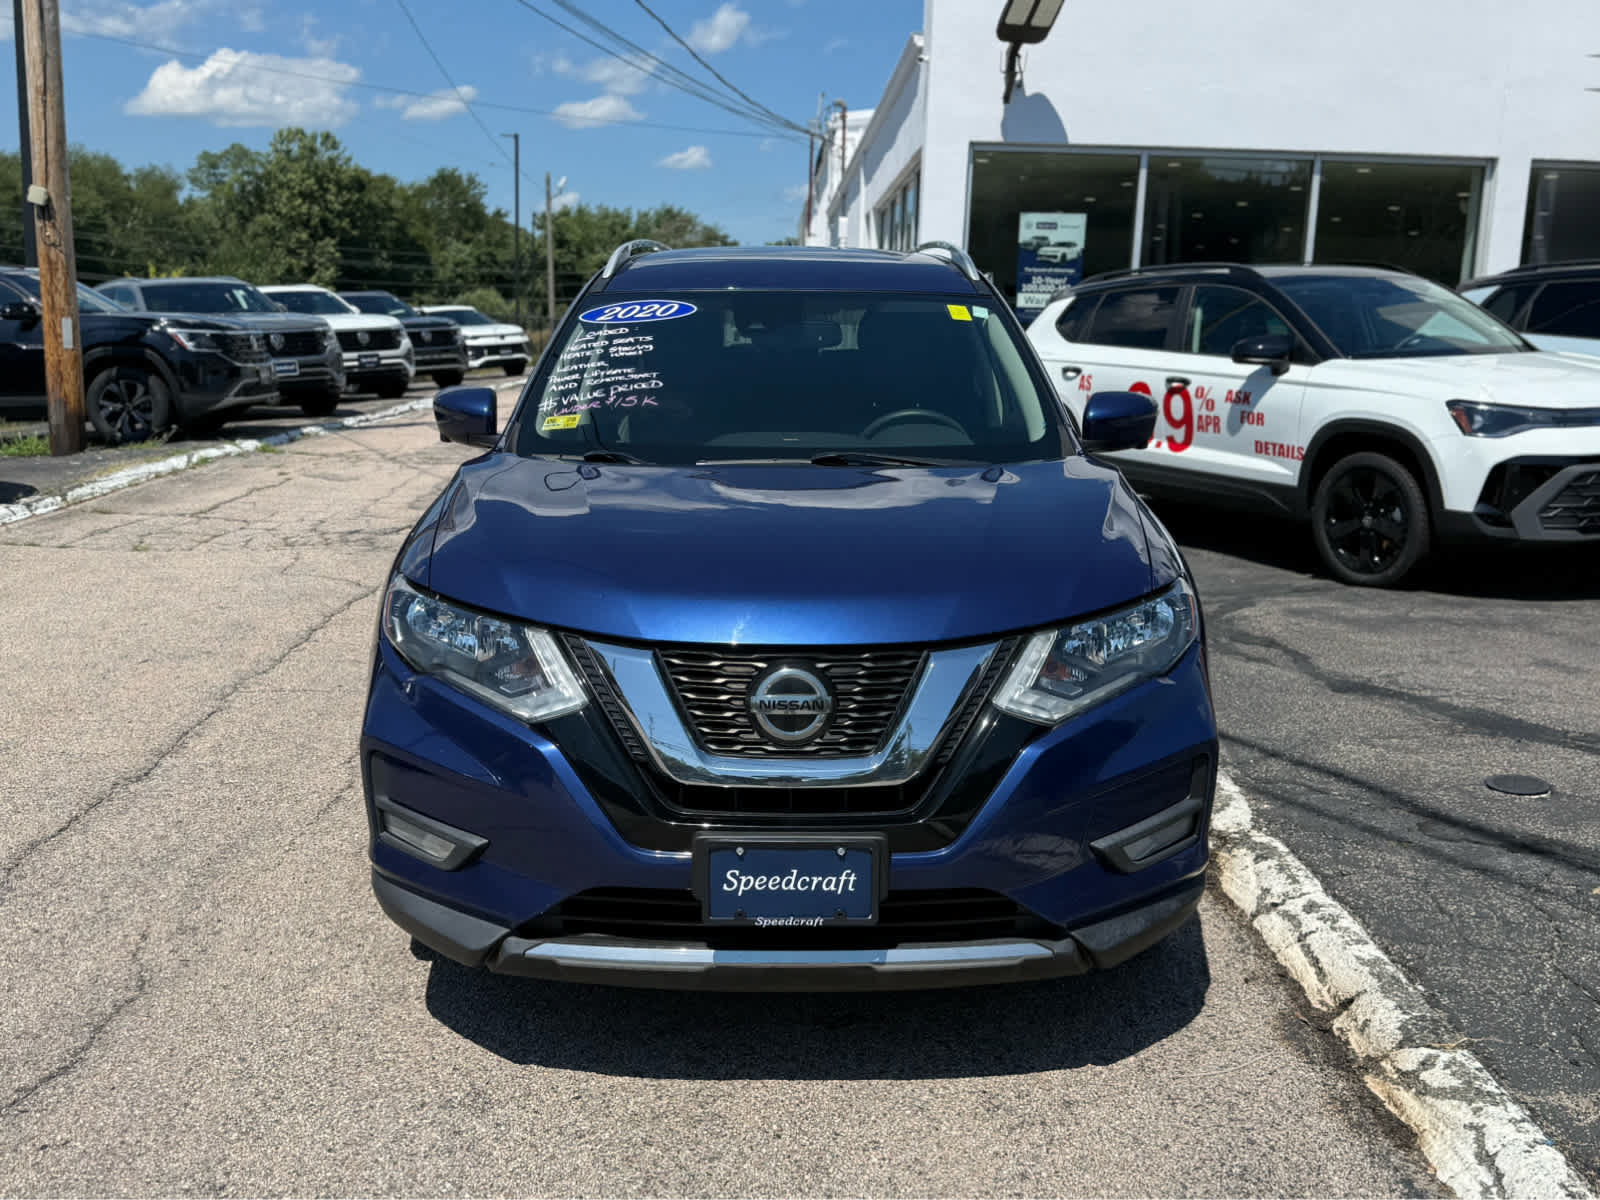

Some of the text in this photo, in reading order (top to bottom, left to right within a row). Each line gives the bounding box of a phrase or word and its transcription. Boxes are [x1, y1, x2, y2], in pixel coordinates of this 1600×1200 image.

[595, 303, 679, 321] 2020
[1078, 374, 1093, 391] AS
[561, 388, 607, 406] VALUE
[1225, 389, 1252, 406] ASK
[1196, 414, 1221, 434] APR
[1240, 410, 1265, 427] FOR
[1254, 440, 1305, 461] DETAILS
[760, 700, 824, 711] NISSAN
[722, 869, 857, 897] Speedcraft
[754, 916, 824, 928] Speedcraft
